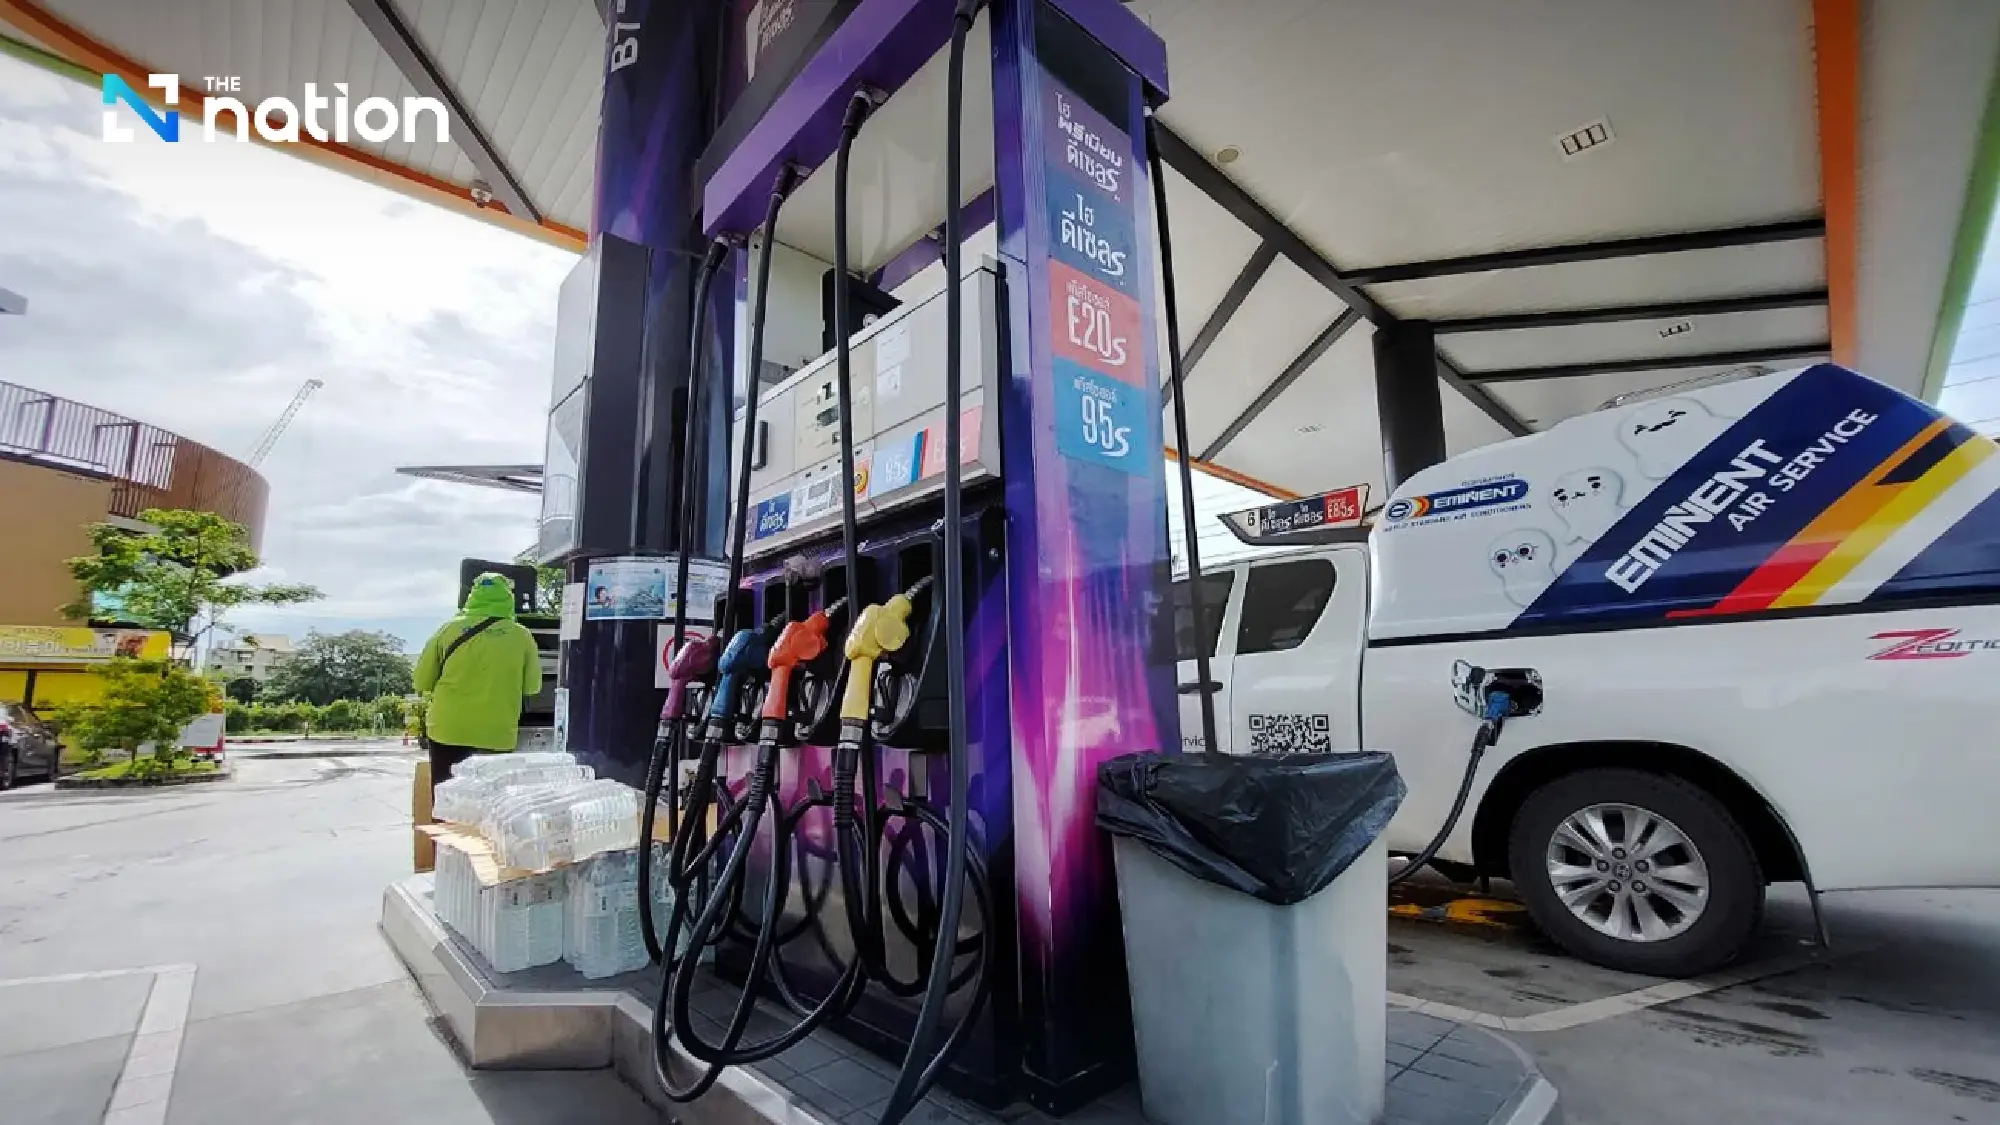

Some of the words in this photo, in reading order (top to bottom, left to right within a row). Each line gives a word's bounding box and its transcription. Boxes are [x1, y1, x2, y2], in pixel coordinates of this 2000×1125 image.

[1727, 491, 1776, 532] AIR
[1768, 408, 1879, 492] SERVICE
[1433, 484, 1521, 508] EMINENT
[1247, 511, 1256, 527] 6
[1605, 438, 1783, 593] EMINENT
[1184, 733, 1205, 747] rvic
